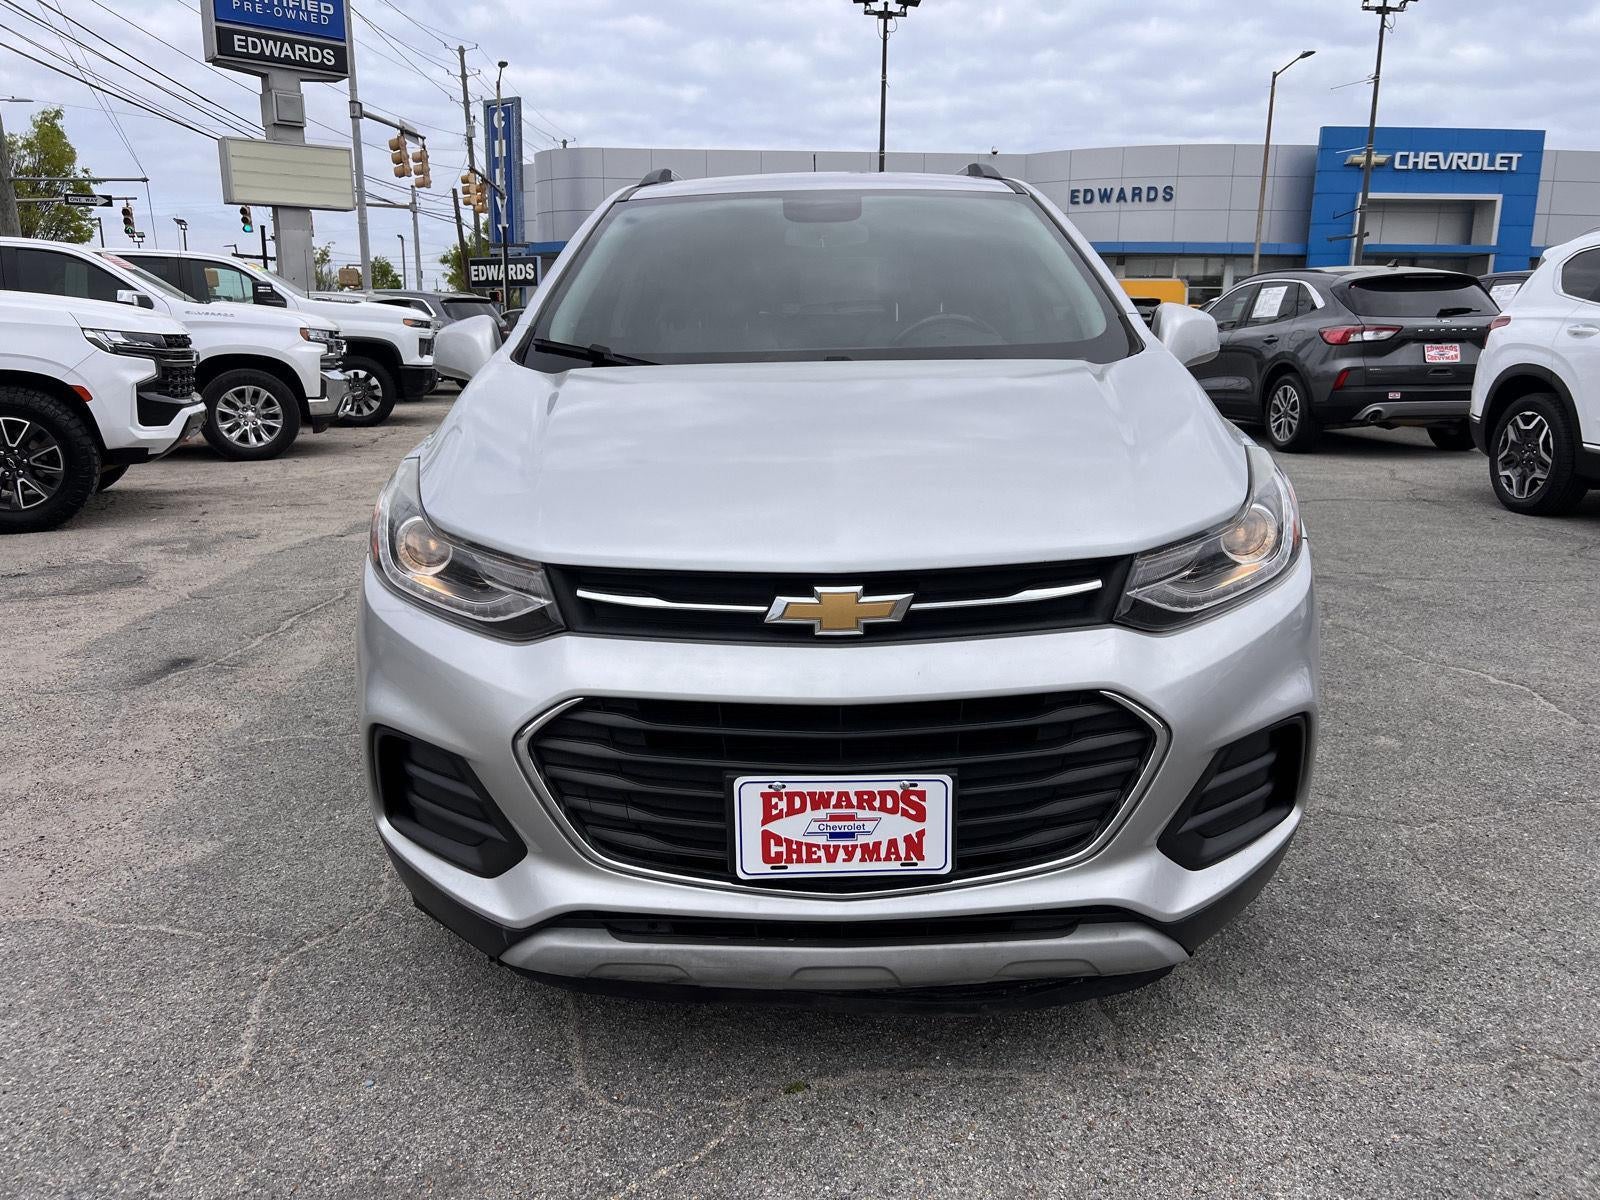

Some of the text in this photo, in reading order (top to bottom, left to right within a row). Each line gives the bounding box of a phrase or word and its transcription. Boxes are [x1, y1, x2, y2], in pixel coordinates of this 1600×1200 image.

[232, 0, 329, 25] PRE-OWNED
[256, 0, 334, 15] IFIED
[233, 34, 336, 66] EDWARDS
[1393, 151, 1523, 172] CHEVROLET
[1070, 185, 1175, 206] EDWARDS
[470, 263, 535, 281] EDWARDS
[760, 789, 927, 827] EDWARDS
[817, 822, 867, 832] Chevrolet
[760, 828, 927, 865] CHEVYMAN
